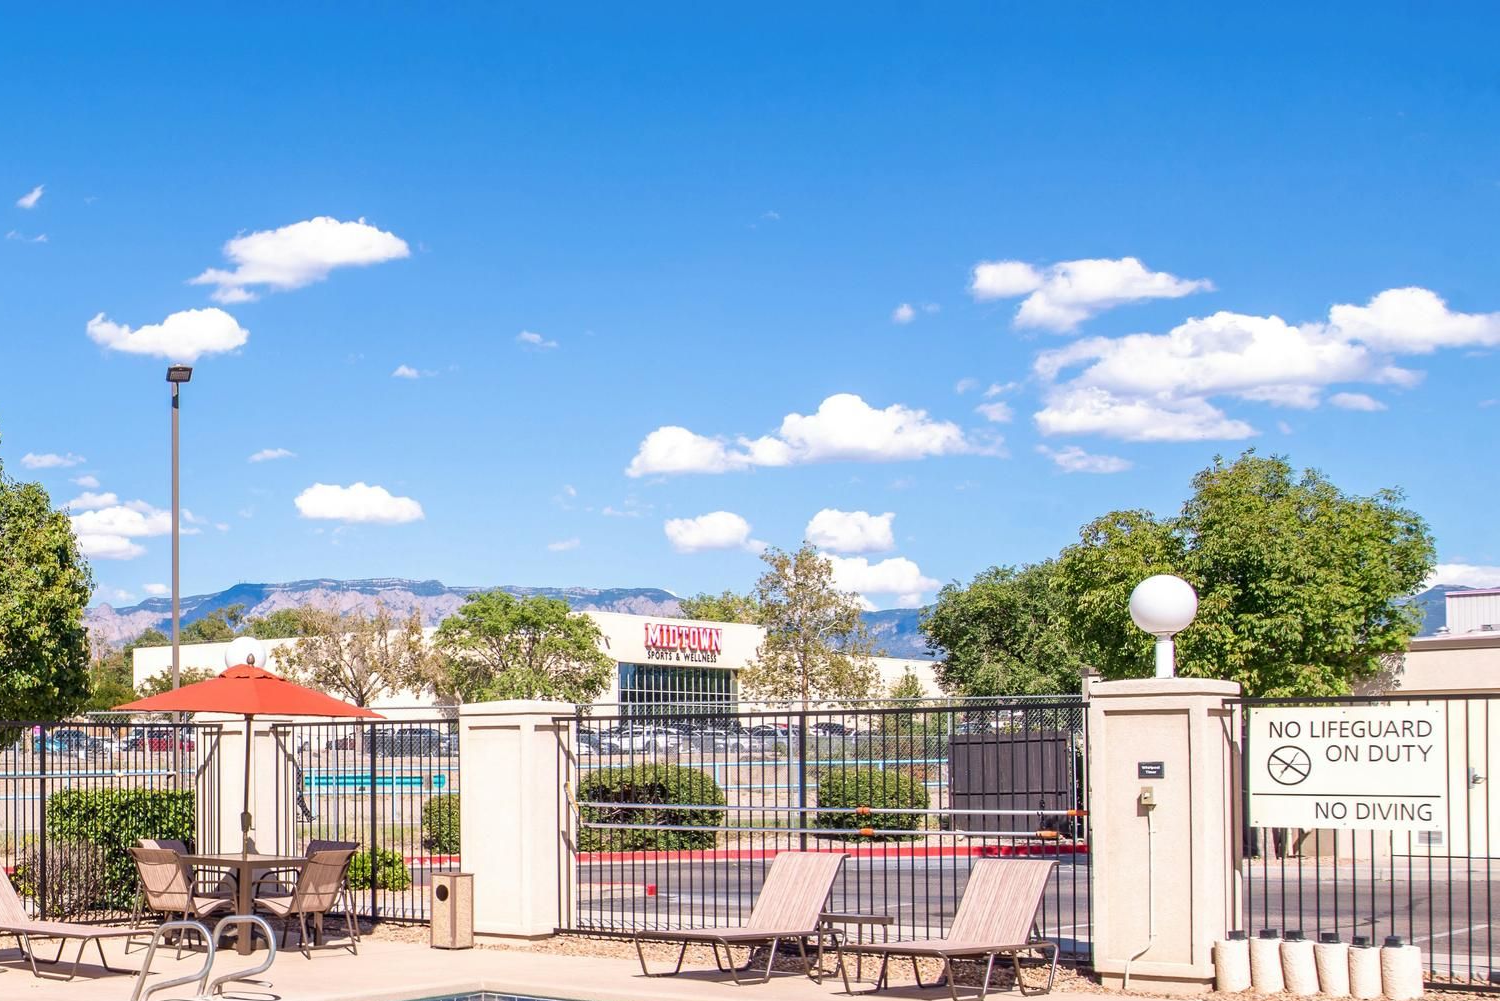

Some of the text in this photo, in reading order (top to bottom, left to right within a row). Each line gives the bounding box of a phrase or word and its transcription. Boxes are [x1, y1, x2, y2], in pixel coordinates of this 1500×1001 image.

[645, 623, 722, 653] MIDTOWN
[647, 651, 717, 663] SPORTS & WELLNESS
[1269, 720, 1432, 738] NO LIFEGUARD
[1326, 745, 1433, 762] ON DUTY
[1315, 802, 1432, 821] NO DIVING
